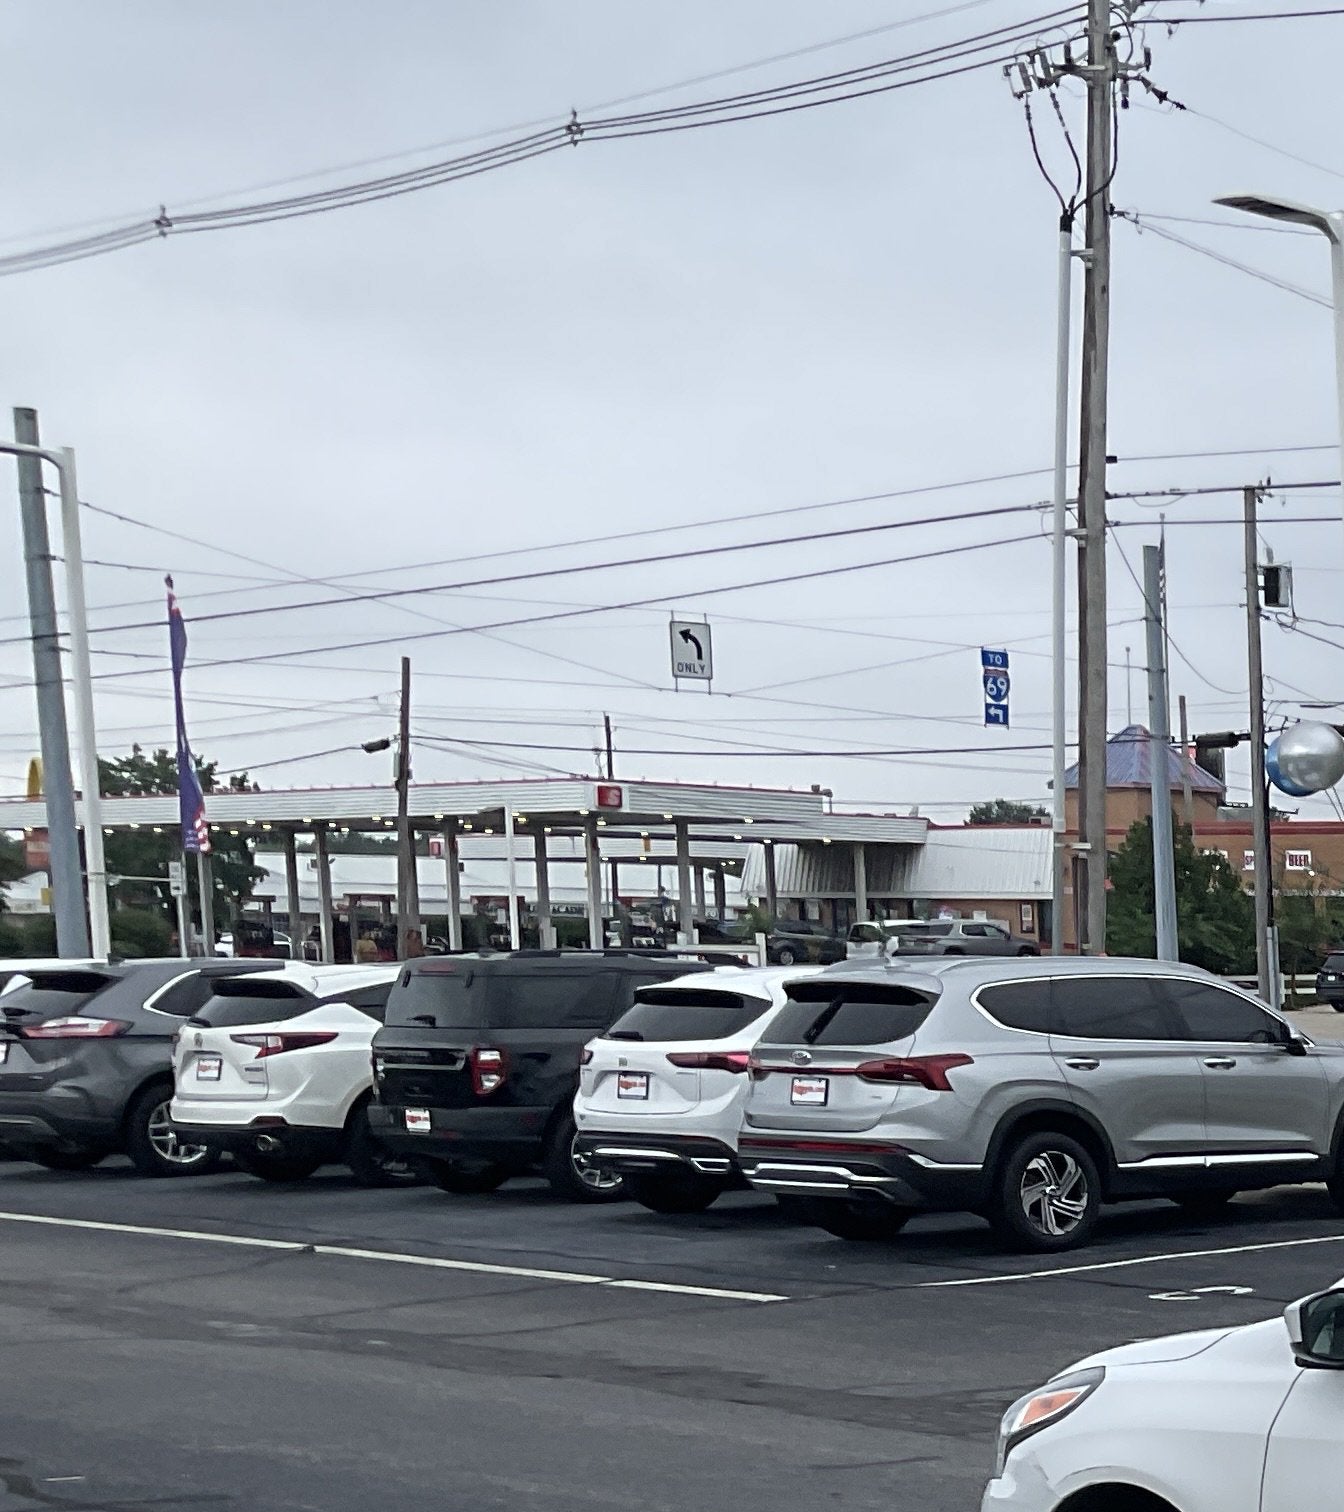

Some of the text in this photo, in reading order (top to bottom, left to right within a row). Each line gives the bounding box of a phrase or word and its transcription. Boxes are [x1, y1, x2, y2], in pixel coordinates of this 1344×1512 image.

[988, 653, 1003, 665] TO
[676, 661, 706, 675] ONLY
[986, 677, 1007, 697] 69
